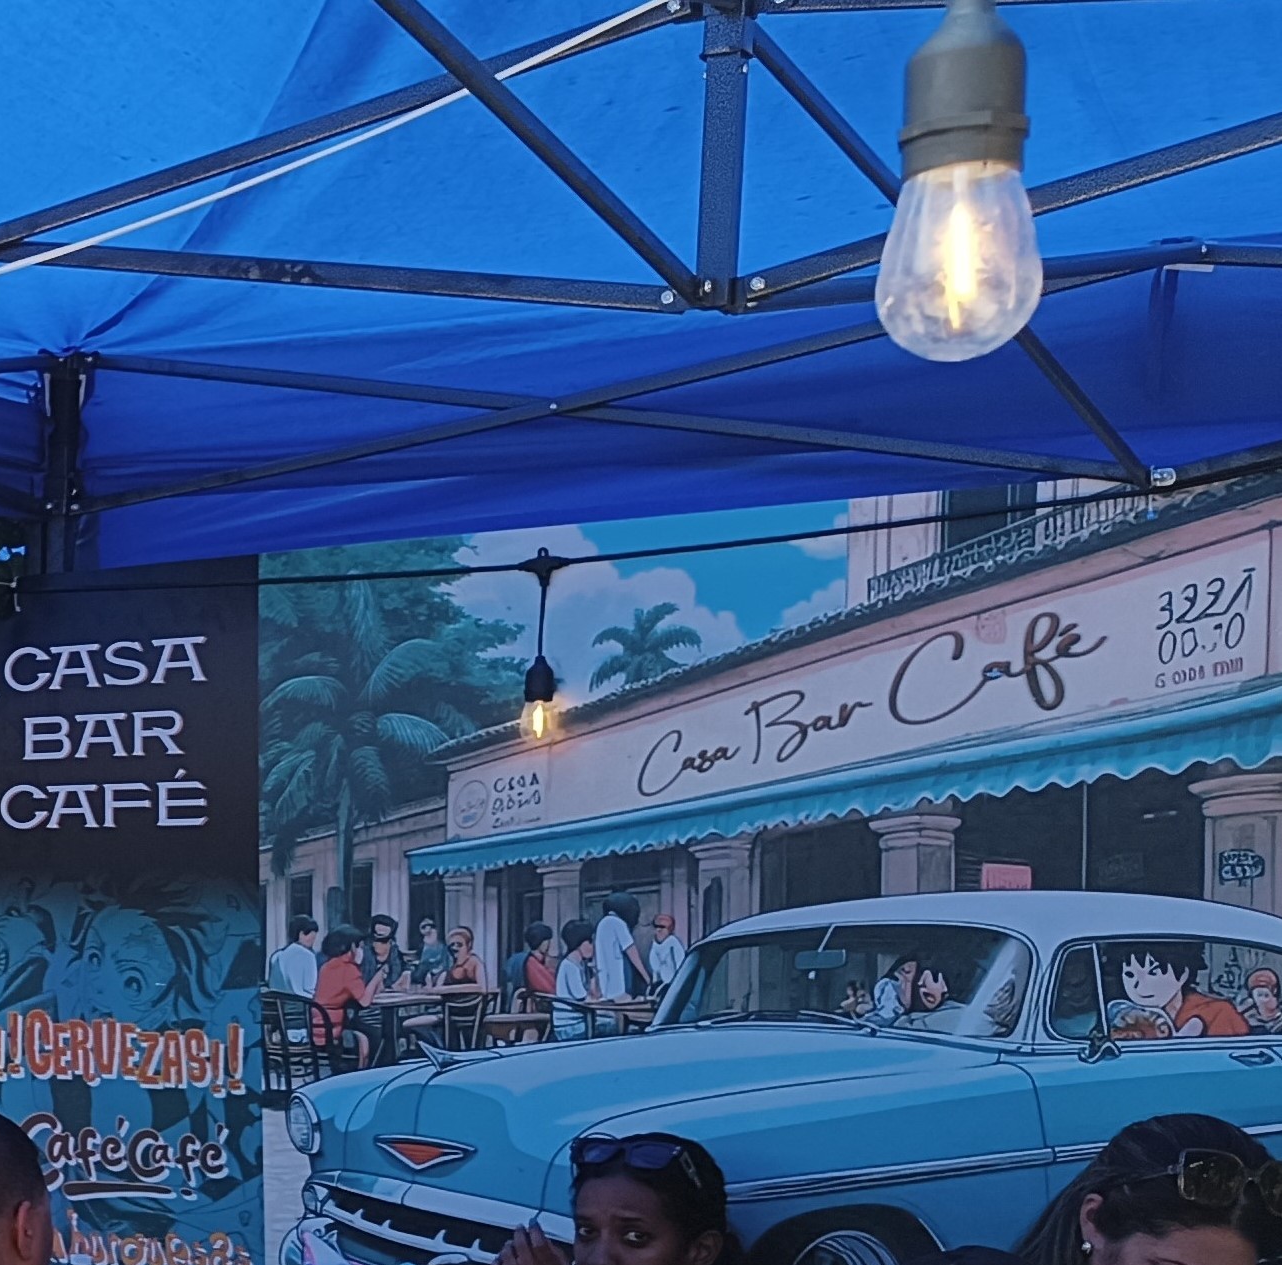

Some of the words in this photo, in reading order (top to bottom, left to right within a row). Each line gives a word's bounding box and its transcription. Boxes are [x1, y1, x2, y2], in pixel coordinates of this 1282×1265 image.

[3, 636, 209, 692] CASA
[637, 730, 741, 797] Casa
[744, 689, 873, 765] Bar
[889, 611, 1108, 726] Café
[22, 710, 185, 760] BAR
[0, 768, 210, 830] CAFÉ
